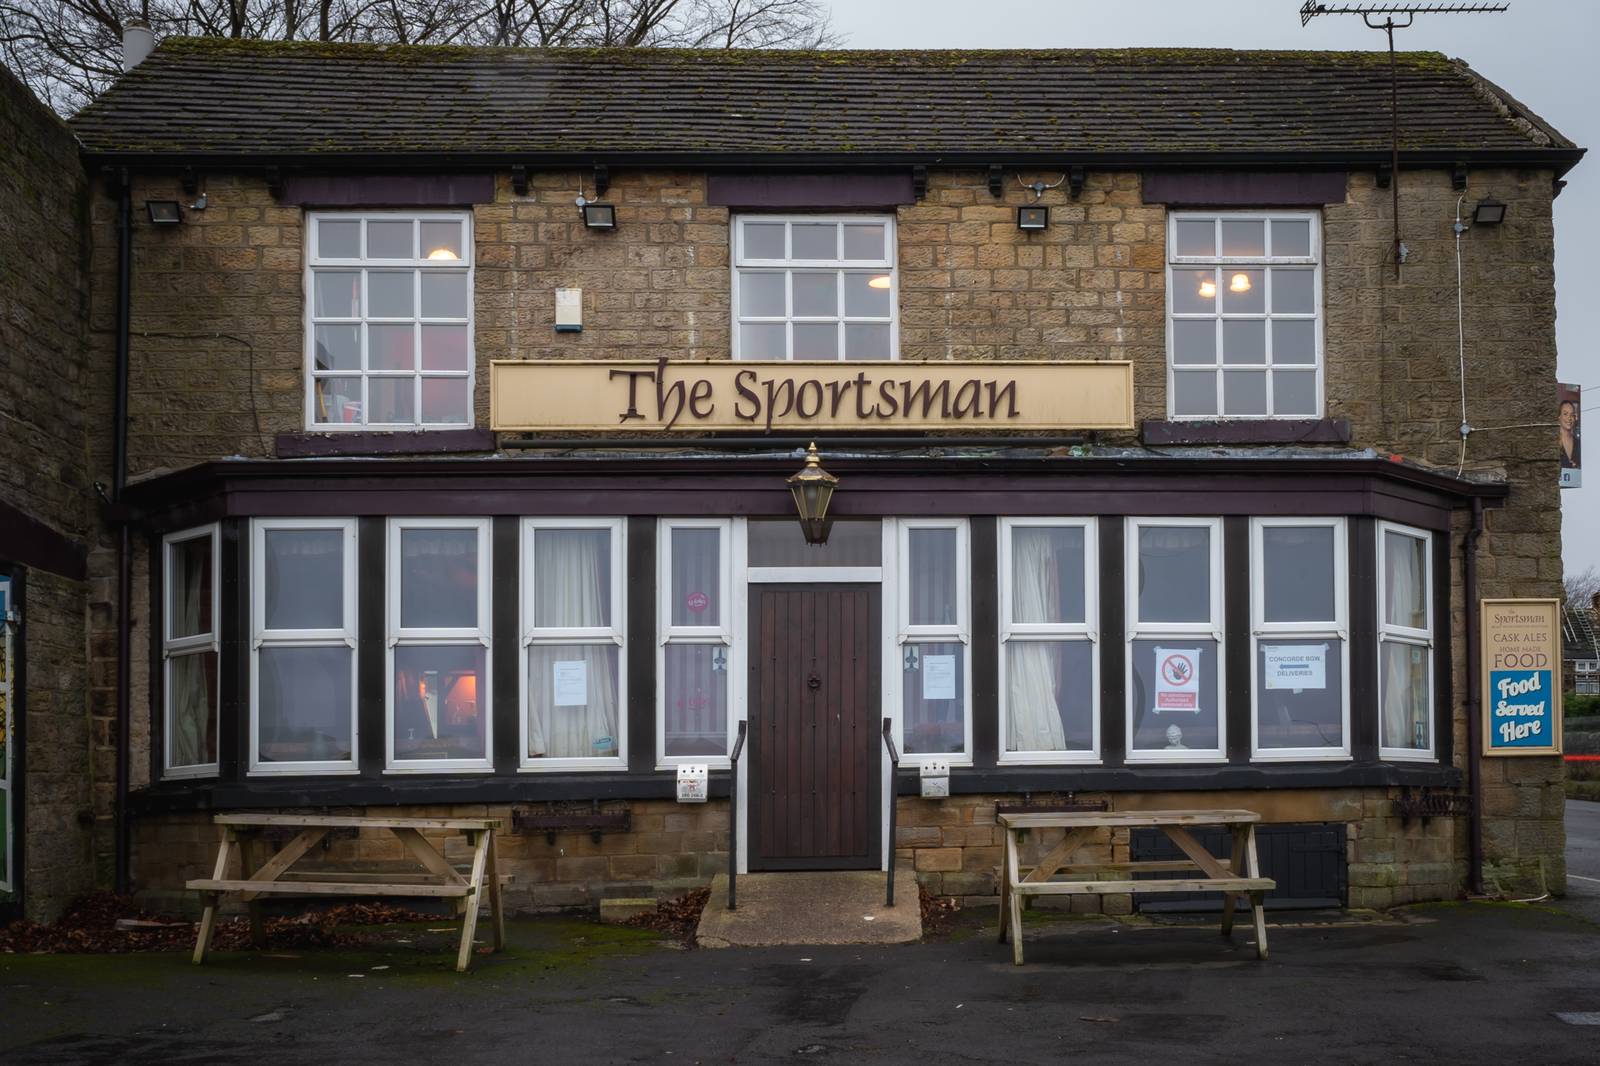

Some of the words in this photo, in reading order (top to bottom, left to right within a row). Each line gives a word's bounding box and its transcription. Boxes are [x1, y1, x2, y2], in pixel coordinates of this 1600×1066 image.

[609, 357, 715, 431] The
[734, 370, 1020, 434] Sportsman
[1494, 614, 1545, 625] Sportsman
[1493, 633, 1520, 643] CASK
[1523, 632, 1547, 642] ALES
[1494, 653, 1547, 668] FOOD
[1497, 671, 1541, 699] Food
[1496, 700, 1545, 717] Served
[1499, 720, 1541, 743] Here
